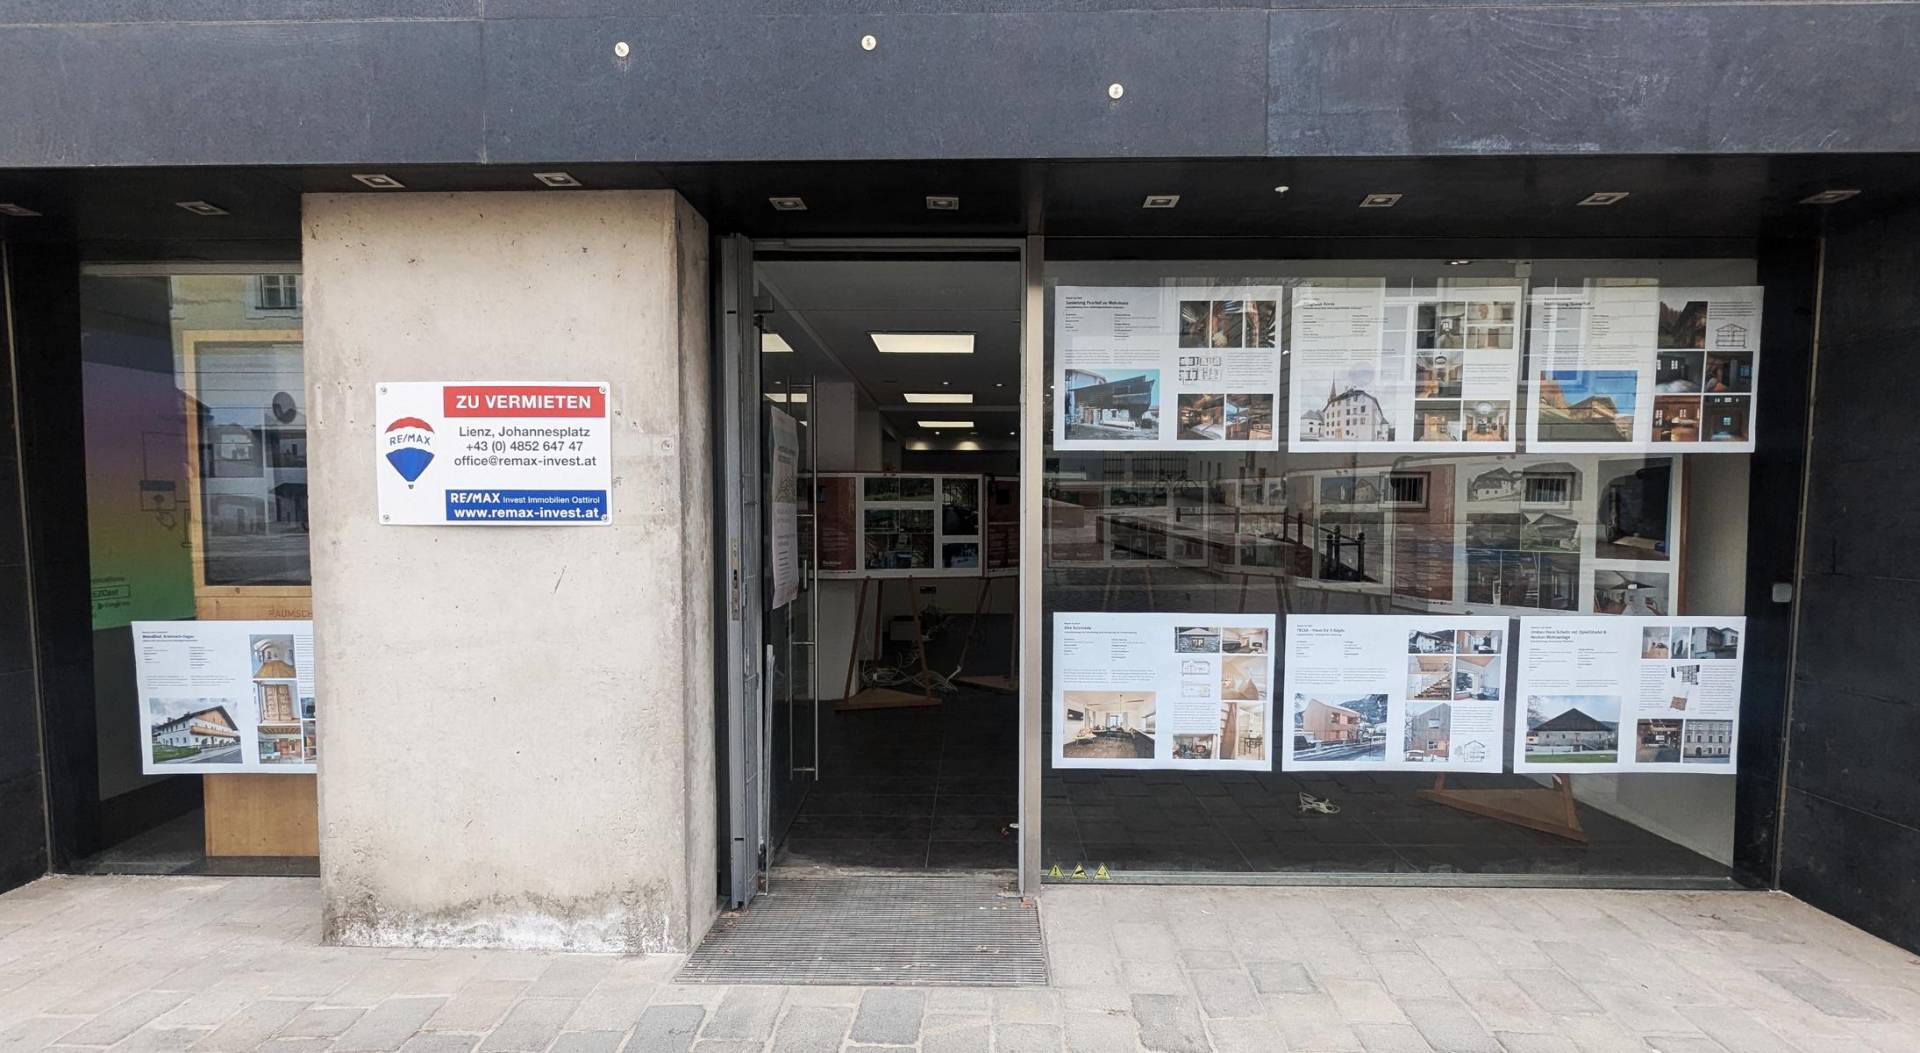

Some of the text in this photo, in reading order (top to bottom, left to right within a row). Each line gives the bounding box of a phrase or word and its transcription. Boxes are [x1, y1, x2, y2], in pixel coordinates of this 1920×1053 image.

[455, 395, 591, 409] ZU VERMIETEN
[459, 426, 591, 439] Lienz, Johannesplatz
[389, 433, 431, 446] RE/MAX
[466, 441, 584, 454] +43 (0) 4852 647 47
[454, 455, 597, 466] office@remax-invest.at
[450, 492, 600, 504] RE/MAX Invest Immobilien Osttirol
[454, 507, 600, 519] www.remax-invest.at
